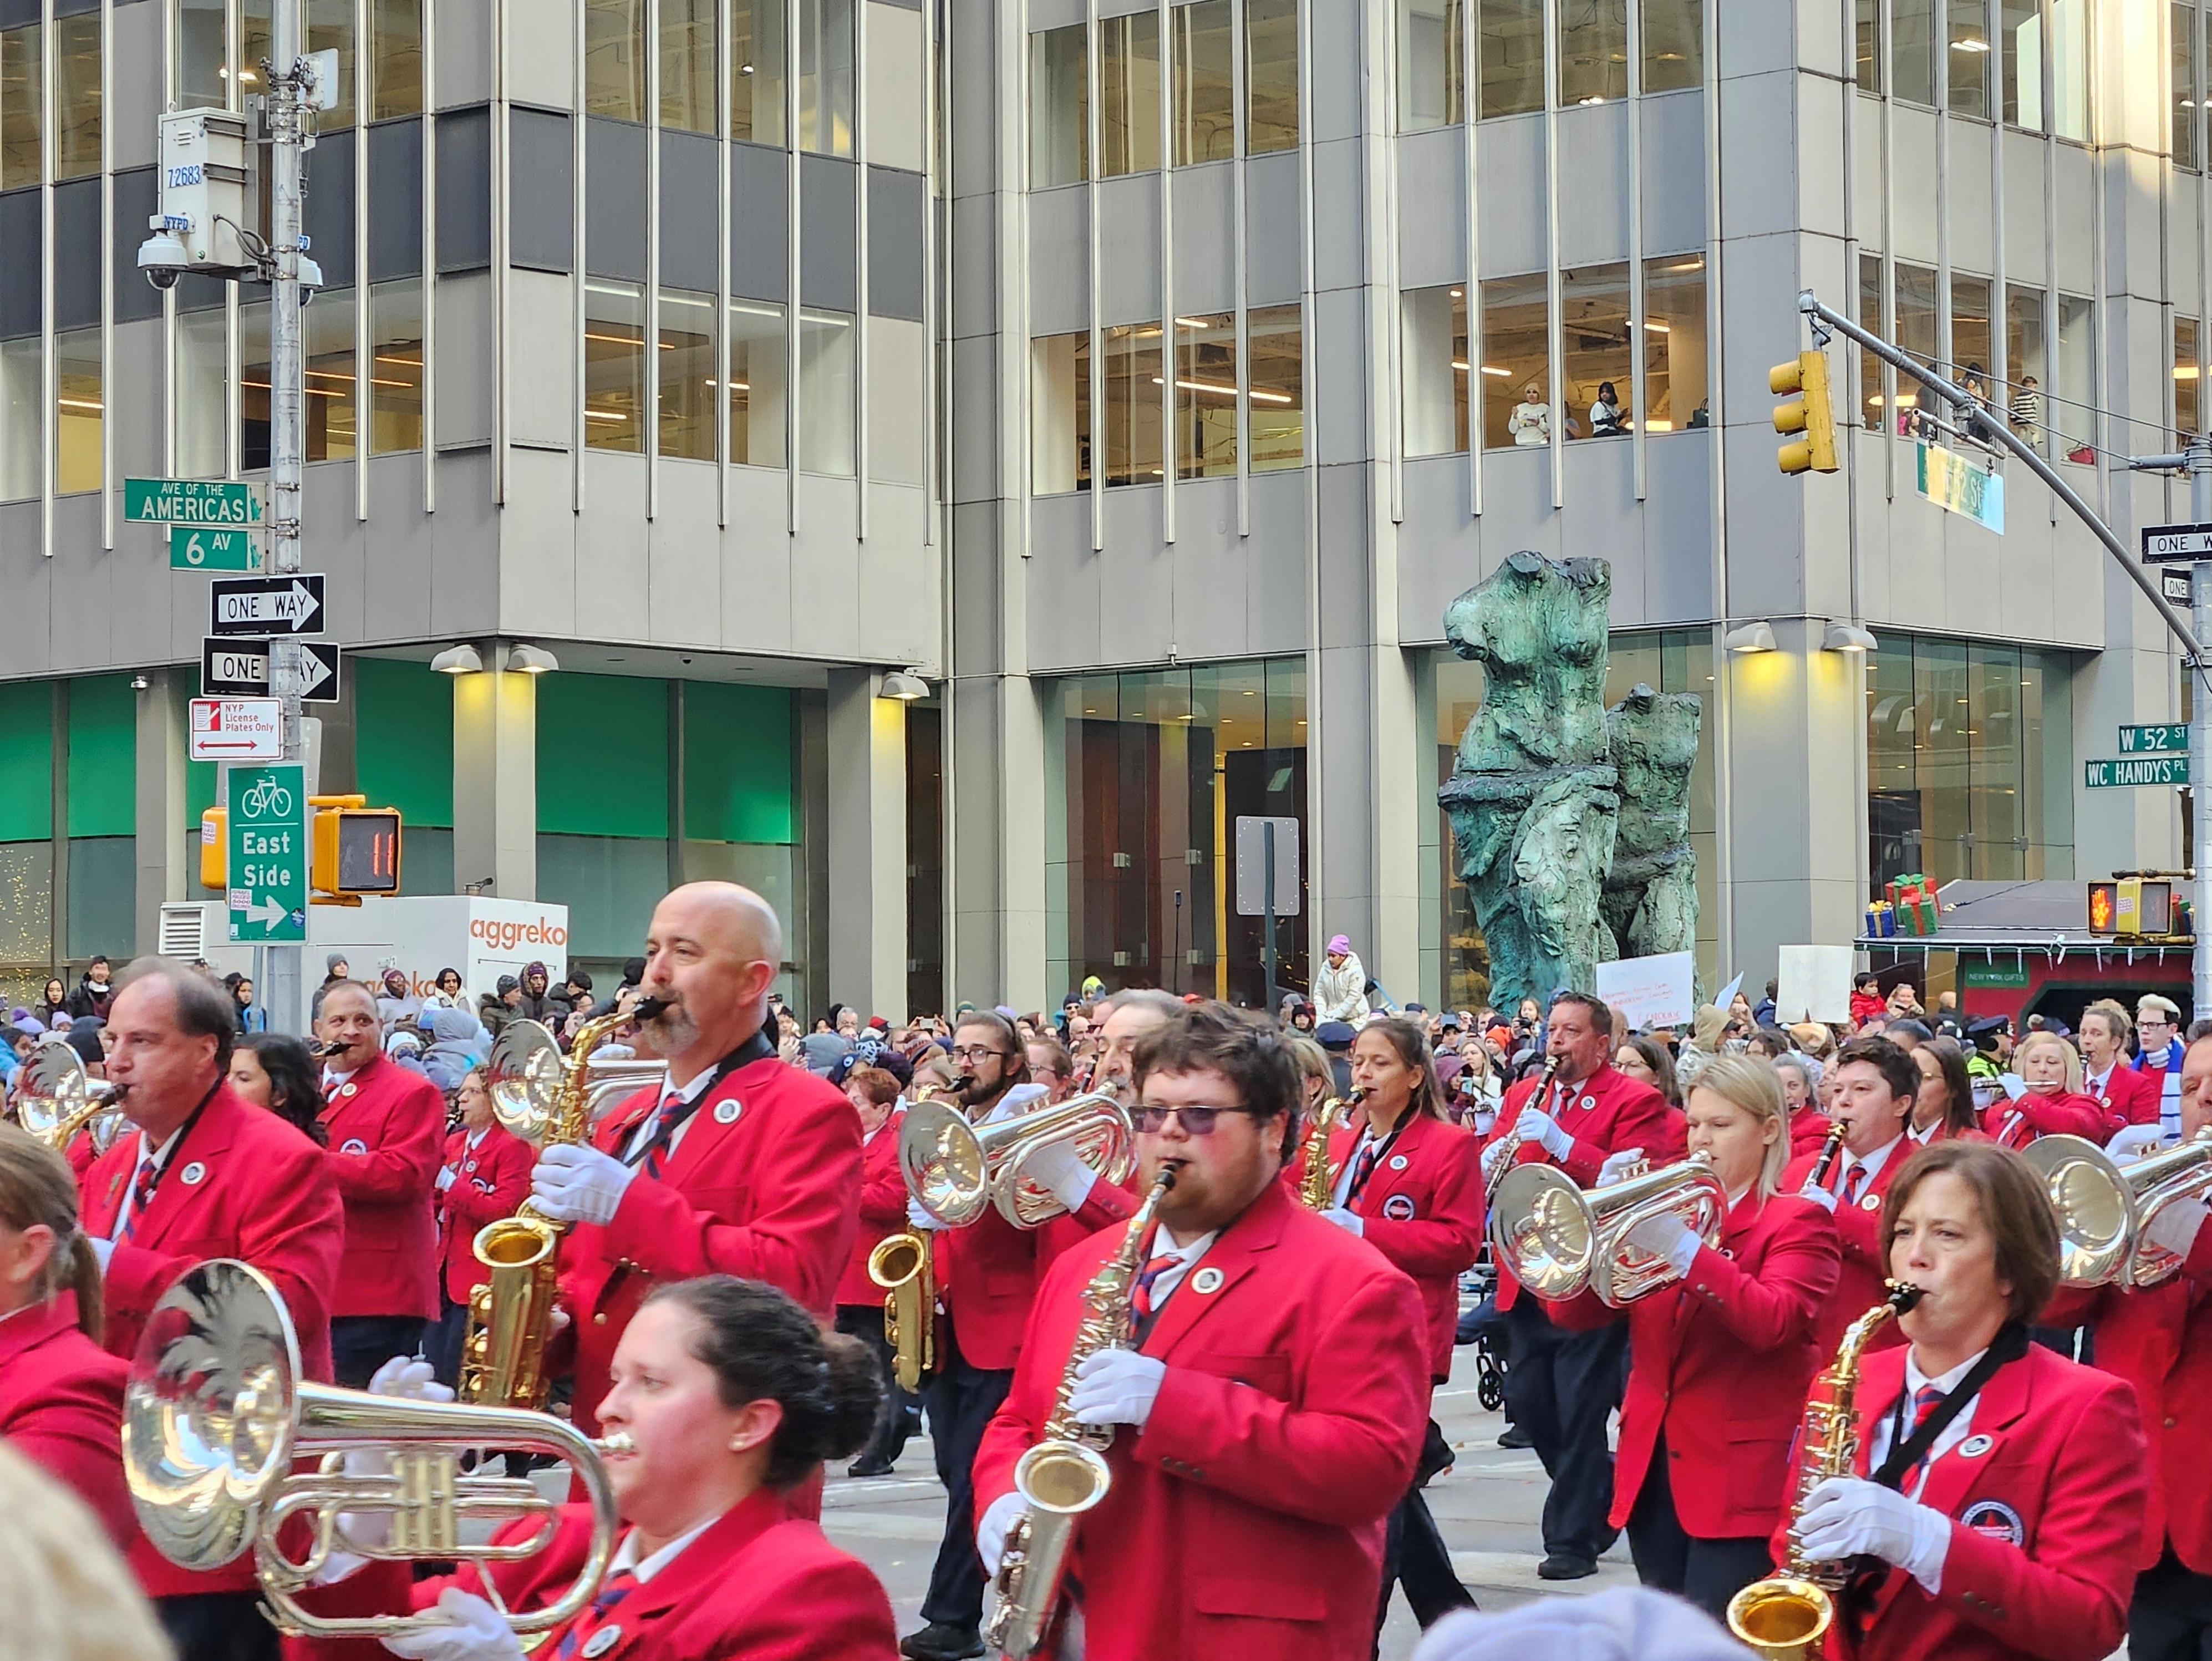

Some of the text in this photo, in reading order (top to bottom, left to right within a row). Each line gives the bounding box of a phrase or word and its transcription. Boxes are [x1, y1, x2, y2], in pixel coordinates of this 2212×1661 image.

[164, 215, 188, 231] NYPD
[161, 482, 224, 496] AVE OF THE
[141, 496, 245, 522] AMERICAS
[186, 532, 231, 565] 6 AV
[2158, 536, 2188, 552] ONE
[2169, 580, 2186, 596] ONE
[228, 594, 307, 619] ONE WAY
[223, 657, 261, 679] ONE
[225, 713, 258, 722] License
[225, 723, 274, 733] Plates Only
[2121, 726, 2185, 751] W 52 ST
[2088, 760, 2186, 786] WC HANDY'S PL
[243, 831, 290, 855] East
[373, 832, 394, 877] 11
[244, 863, 291, 886] Side
[470, 917, 567, 950] aggreko
